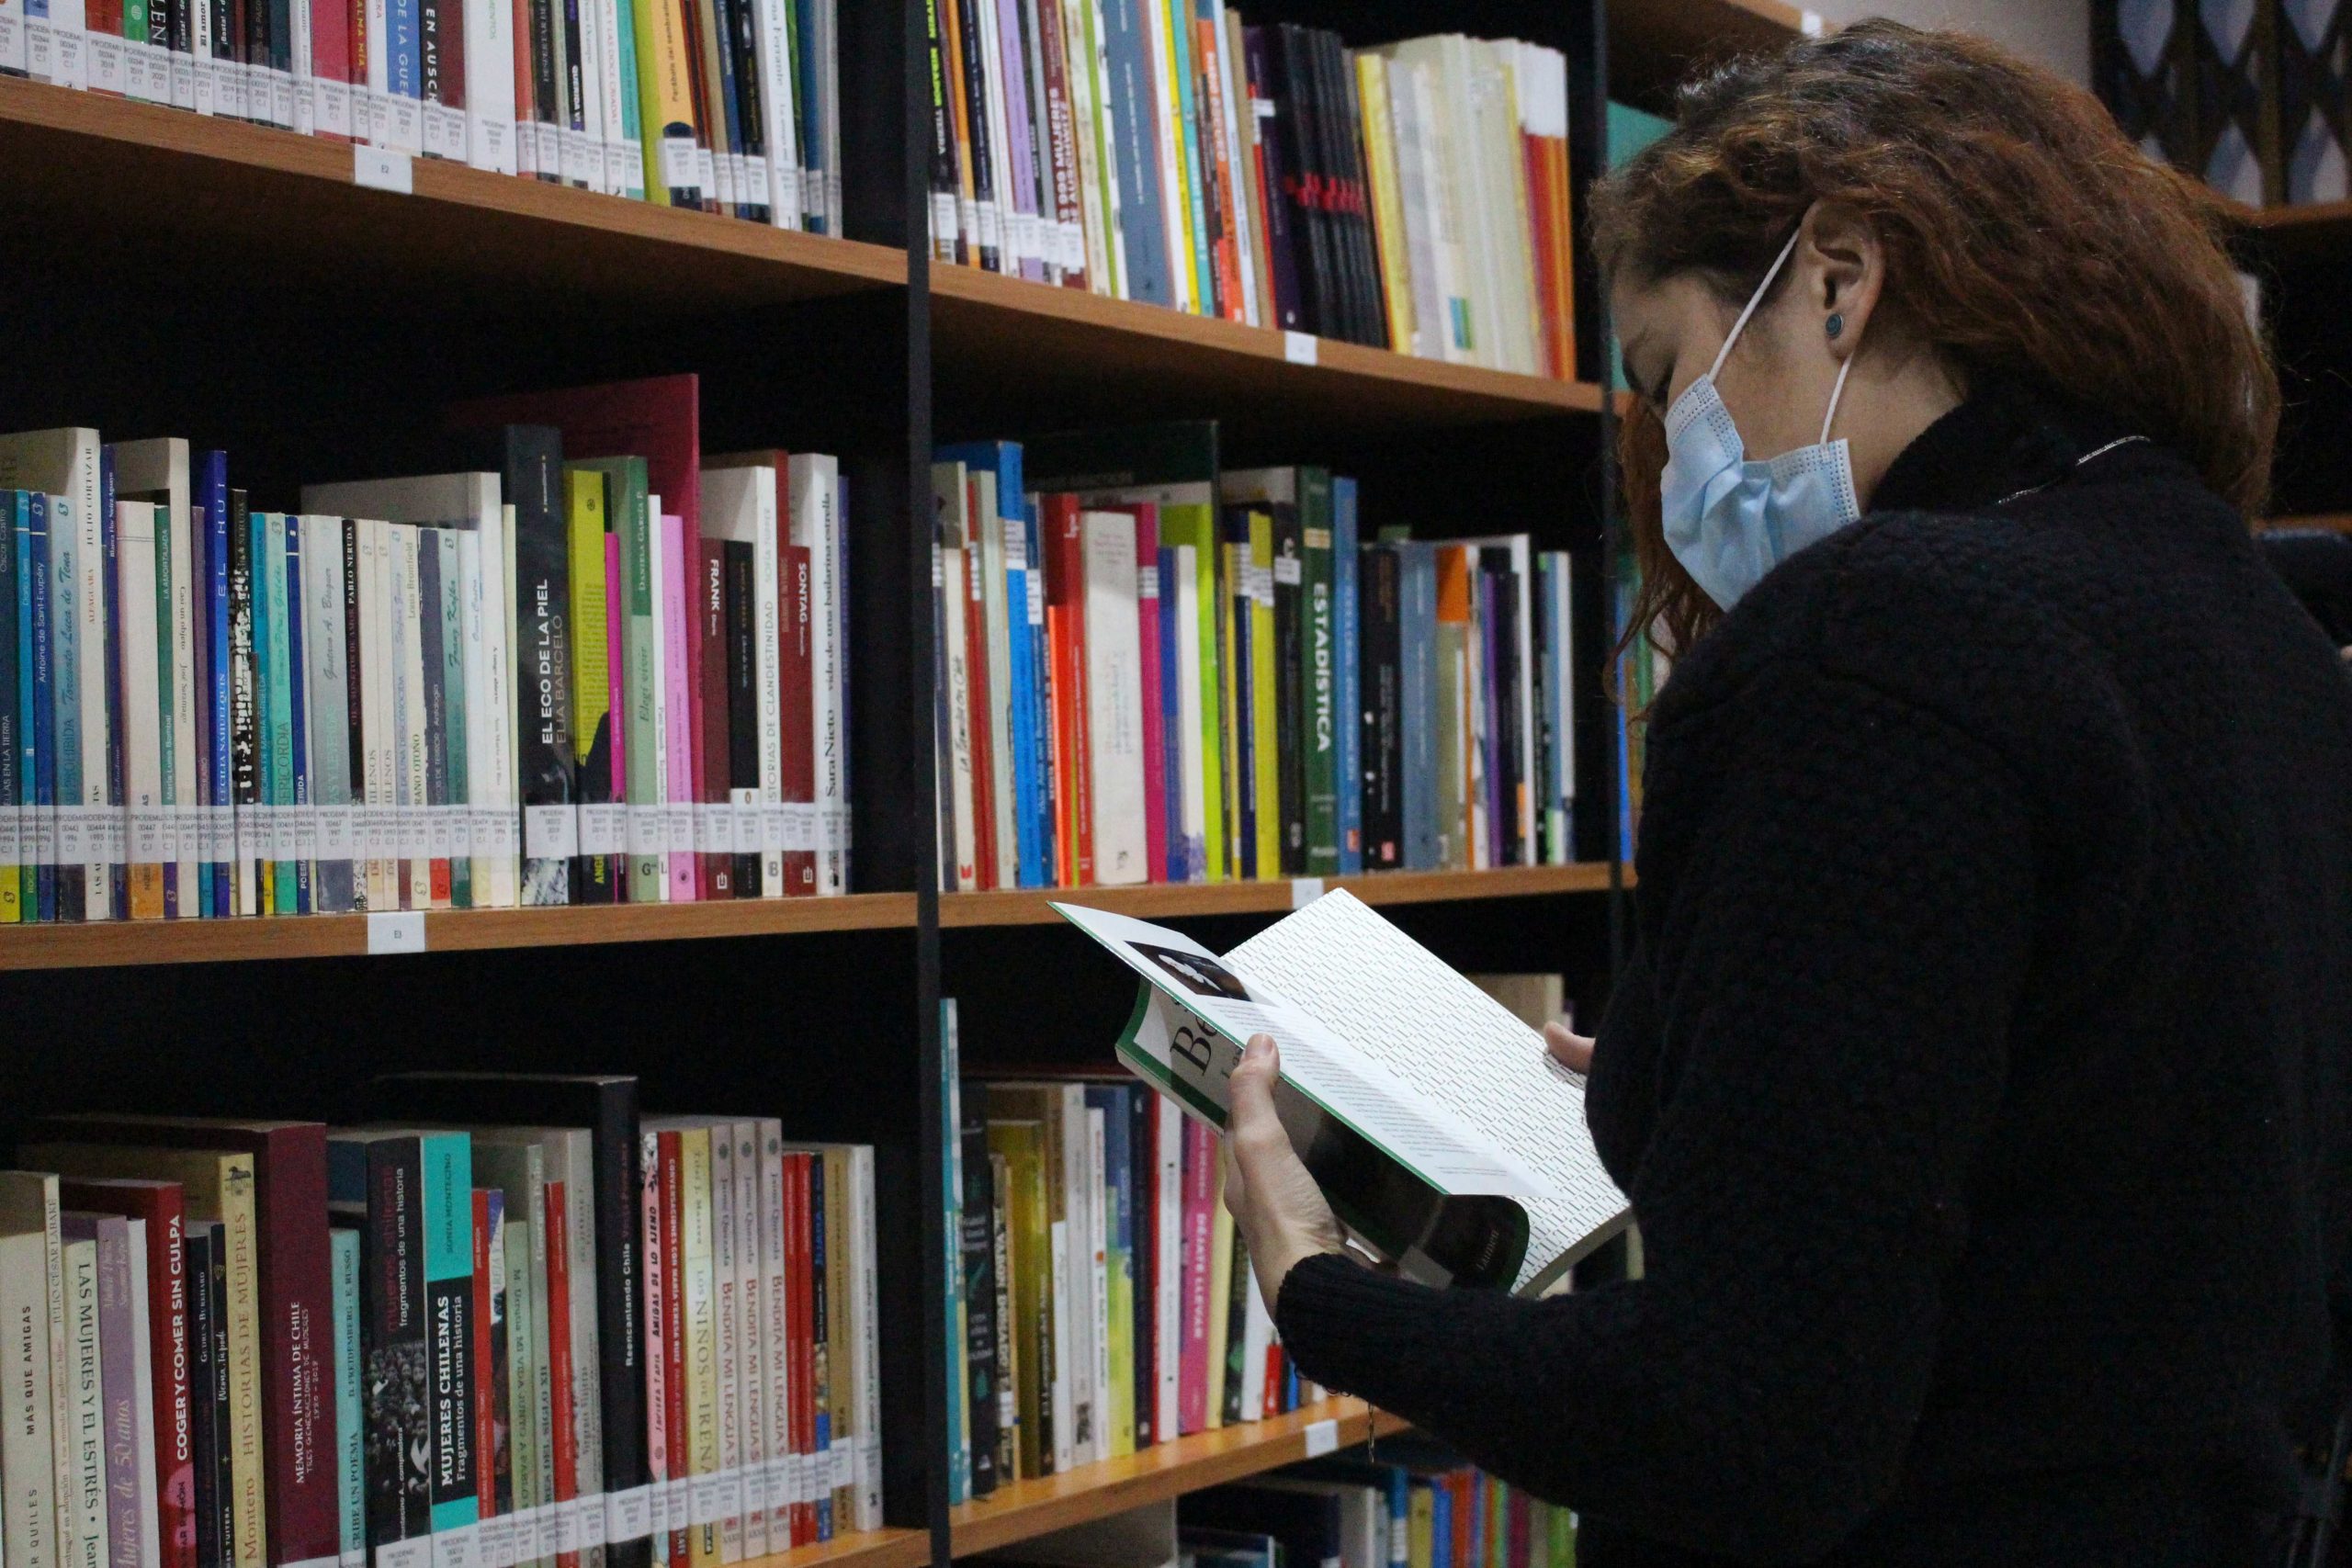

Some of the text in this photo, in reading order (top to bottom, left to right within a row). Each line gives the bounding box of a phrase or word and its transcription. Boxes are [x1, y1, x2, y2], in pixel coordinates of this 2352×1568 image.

[200, 35, 207, 47] El
[398, 27, 406, 45] LA
[425, 8, 435, 31] EN
[85, 513, 94, 547] JULIO
[822, 492, 831, 542] estrella
[57, 551, 72, 583] Tena
[345, 525, 355, 604] PABLO NERUDA
[638, 544, 647, 591] DANIELA
[711, 558, 720, 612] FRANK
[61, 588, 72, 604] de
[797, 562, 808, 623] SONTAG
[38, 629, 45, 643] de
[825, 639, 833, 659] de
[38, 645, 47, 682] Antoine
[537, 579, 553, 744] EL ECO DE LA PIEL
[764, 601, 775, 716] CLANDESTINIDAD
[825, 661, 834, 692] vida
[1313, 582, 1332, 752] ESTADÍSTICA
[555, 705, 566, 744] ELIA
[766, 720, 775, 737] DE
[825, 709, 835, 758] Nieto
[766, 743, 777, 803] ISTORIAS
[825, 760, 836, 797] Sara
[394, 1168, 410, 1326] fragmentos de una historia
[649, 1251, 658, 1265] LO
[78, 1263, 92, 1299] LAS
[650, 1271, 660, 1287] DE
[622, 1242, 634, 1367] Reencantando Chile
[650, 1293, 661, 1337] AMIGAS
[721, 1282, 733, 1352] BENDITA
[746, 1279, 757, 1348] BENDITA
[772, 1275, 783, 1345] BENDITA
[22, 1305, 32, 1363] AMIGAS
[77, 1304, 94, 1391] MUJERES
[169, 1214, 187, 1461] COGER Y COMER SIN CULPA
[722, 1358, 733, 1378] MI
[748, 1354, 757, 1374] MI
[774, 1350, 783, 1371] MI
[24, 1369, 34, 1398] QUE
[83, 1394, 96, 1407] Y
[235, 1213, 258, 1560] Montero HISTORIAS DE MUJERES
[290, 1301, 305, 1483] MEMORIA ÍNTIMA DE CHILE
[437, 1295, 454, 1486] MUJERES CHILENAS
[452, 1295, 467, 1481] Fragmentos de una historia
[83, 1412, 96, 1434] EL
[114, 1398, 130, 1442] años
[114, 1442, 131, 1468] 50
[347, 1433, 359, 1483] POEMA
[114, 1477, 134, 1498] de
[28, 1488, 39, 1548] QUILES
